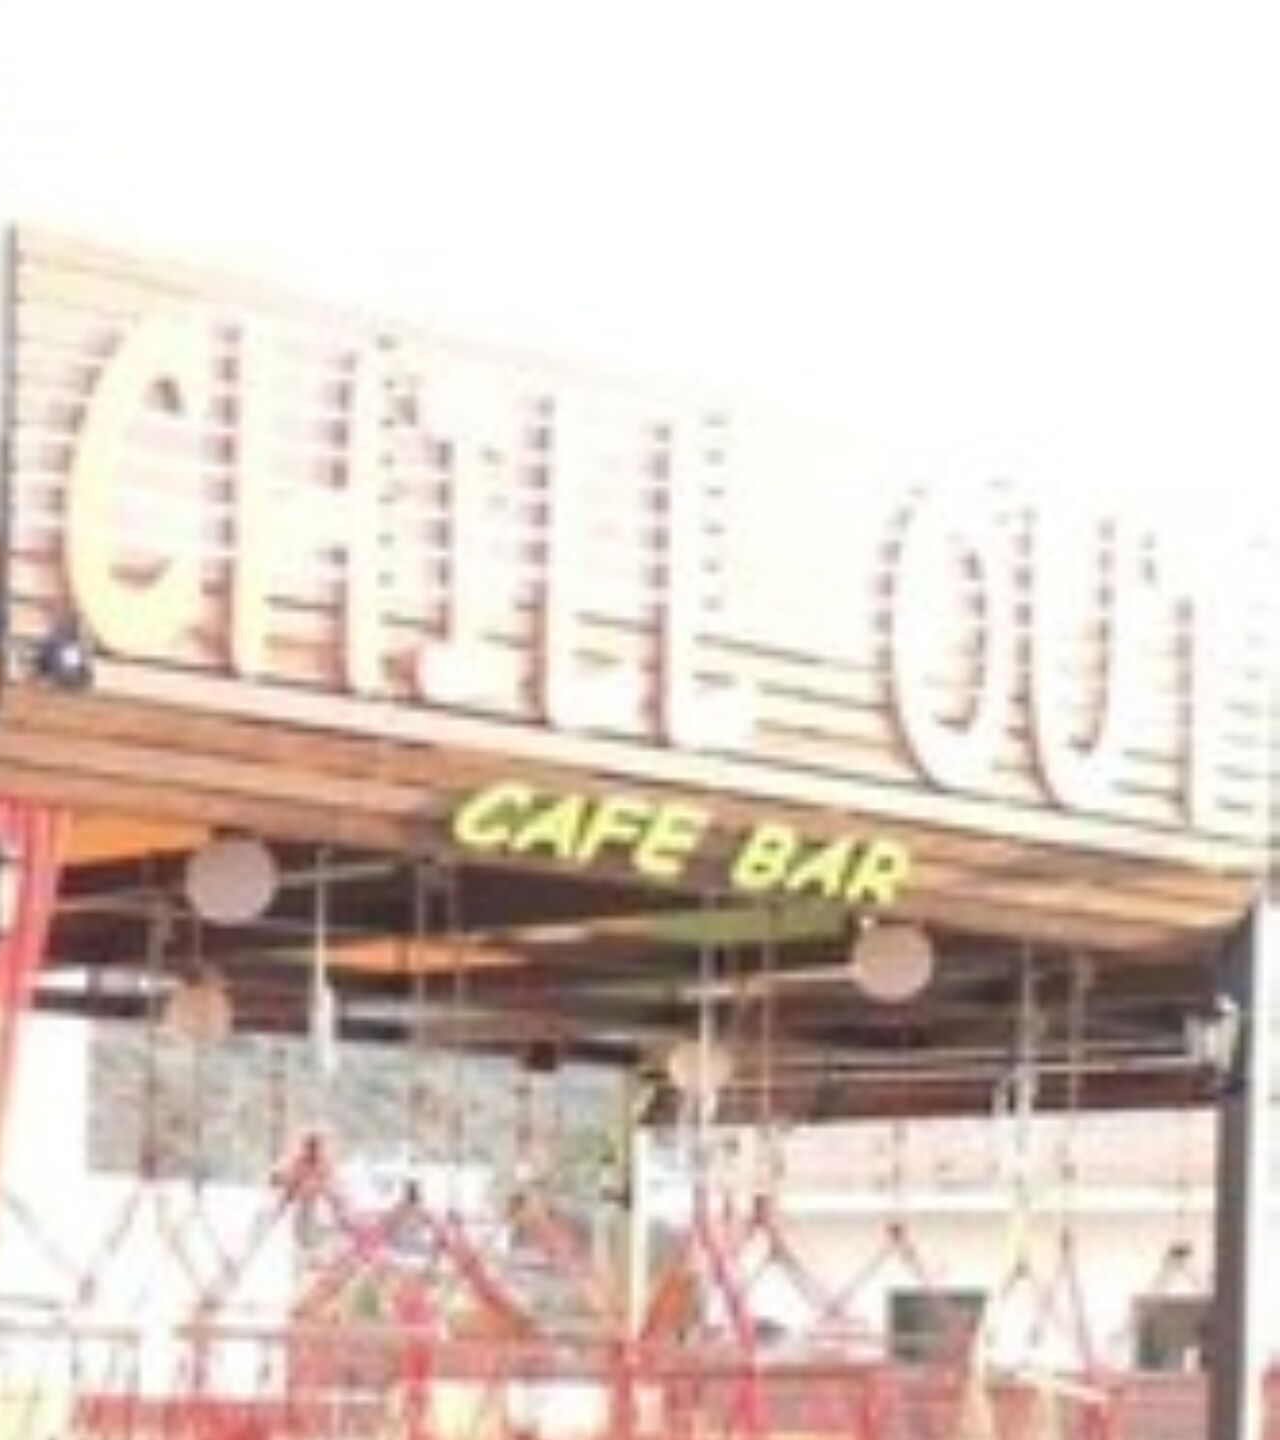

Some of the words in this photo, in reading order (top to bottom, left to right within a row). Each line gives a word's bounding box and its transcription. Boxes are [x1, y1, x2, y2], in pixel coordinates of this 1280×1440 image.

[66, 302, 756, 748] CHILL
[888, 462, 1256, 830] OUT
[451, 782, 708, 876] CAFE
[730, 822, 912, 906] BAR
